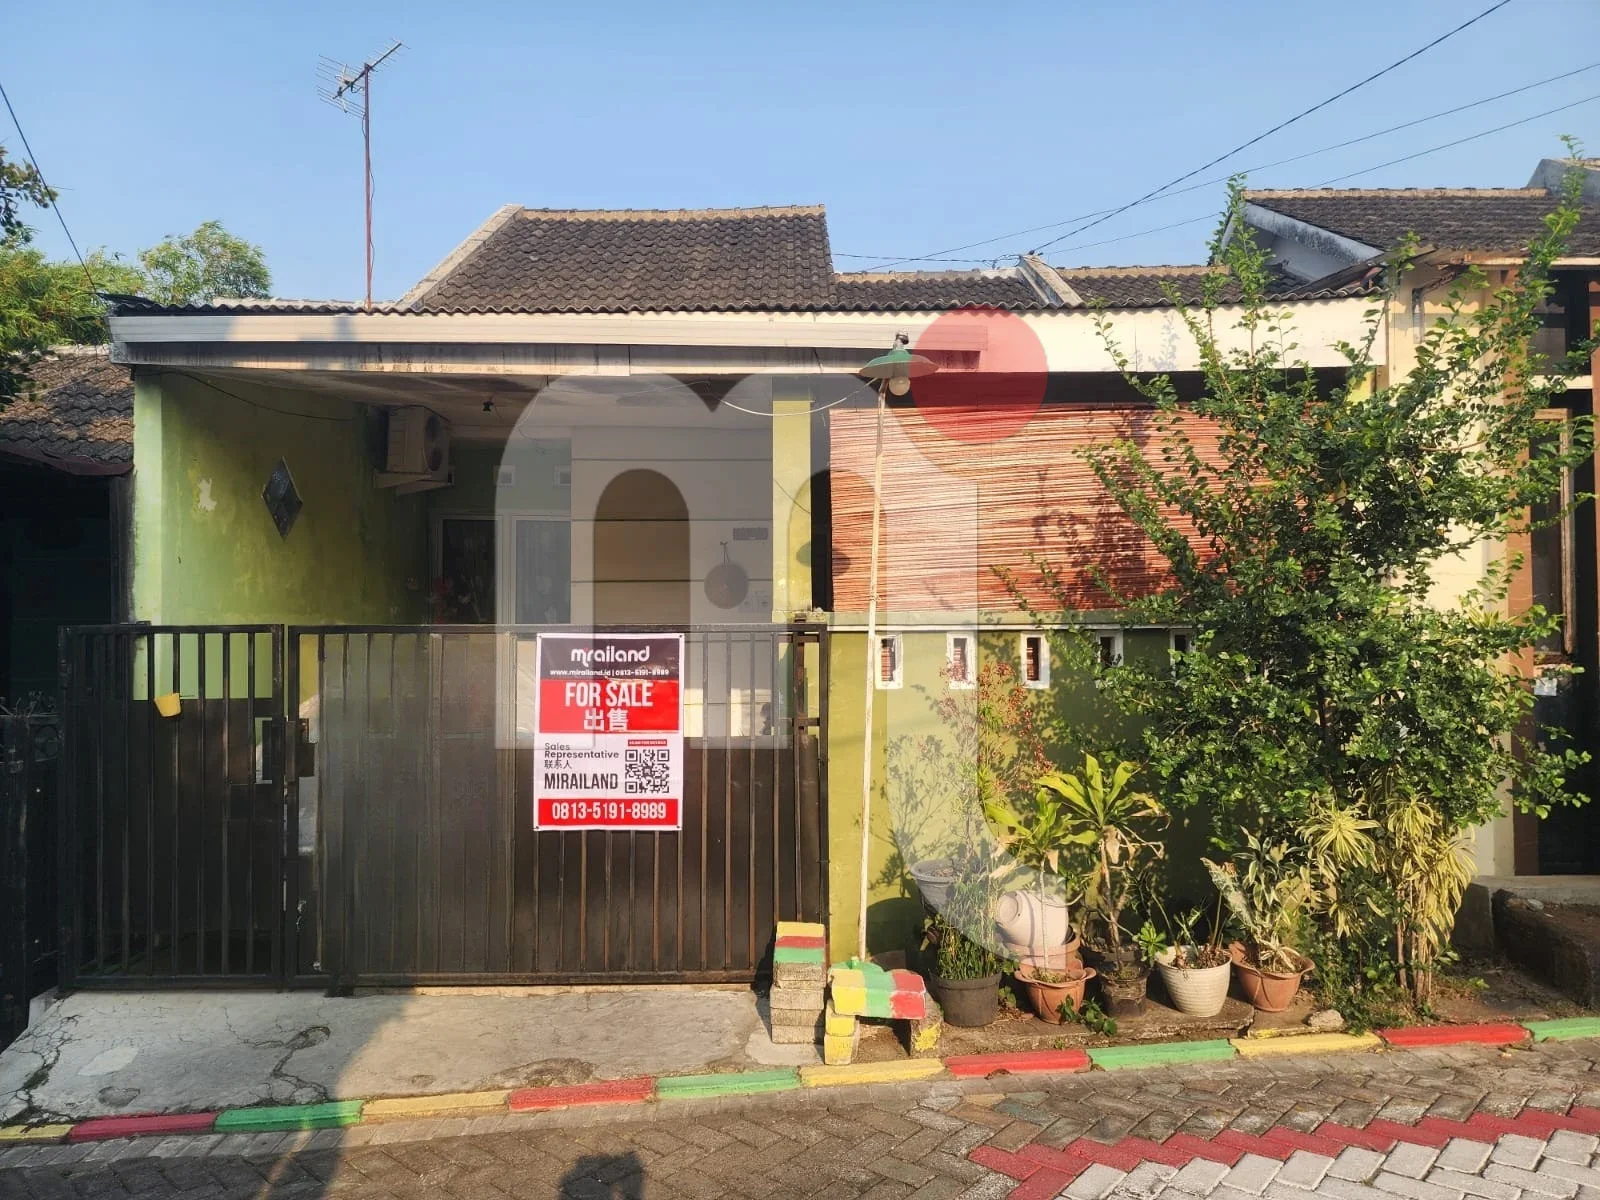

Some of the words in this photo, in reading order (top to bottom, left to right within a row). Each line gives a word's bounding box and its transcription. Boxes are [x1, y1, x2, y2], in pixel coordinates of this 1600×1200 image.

[564, 682, 601, 707] FOR
[605, 681, 654, 707] SALE
[583, 708, 628, 732] 出售
[544, 742, 571, 751] Sales
[544, 750, 620, 761] Representative
[544, 773, 619, 790] MIRAILAND
[551, 801, 667, 820] 0813-5191-8989
